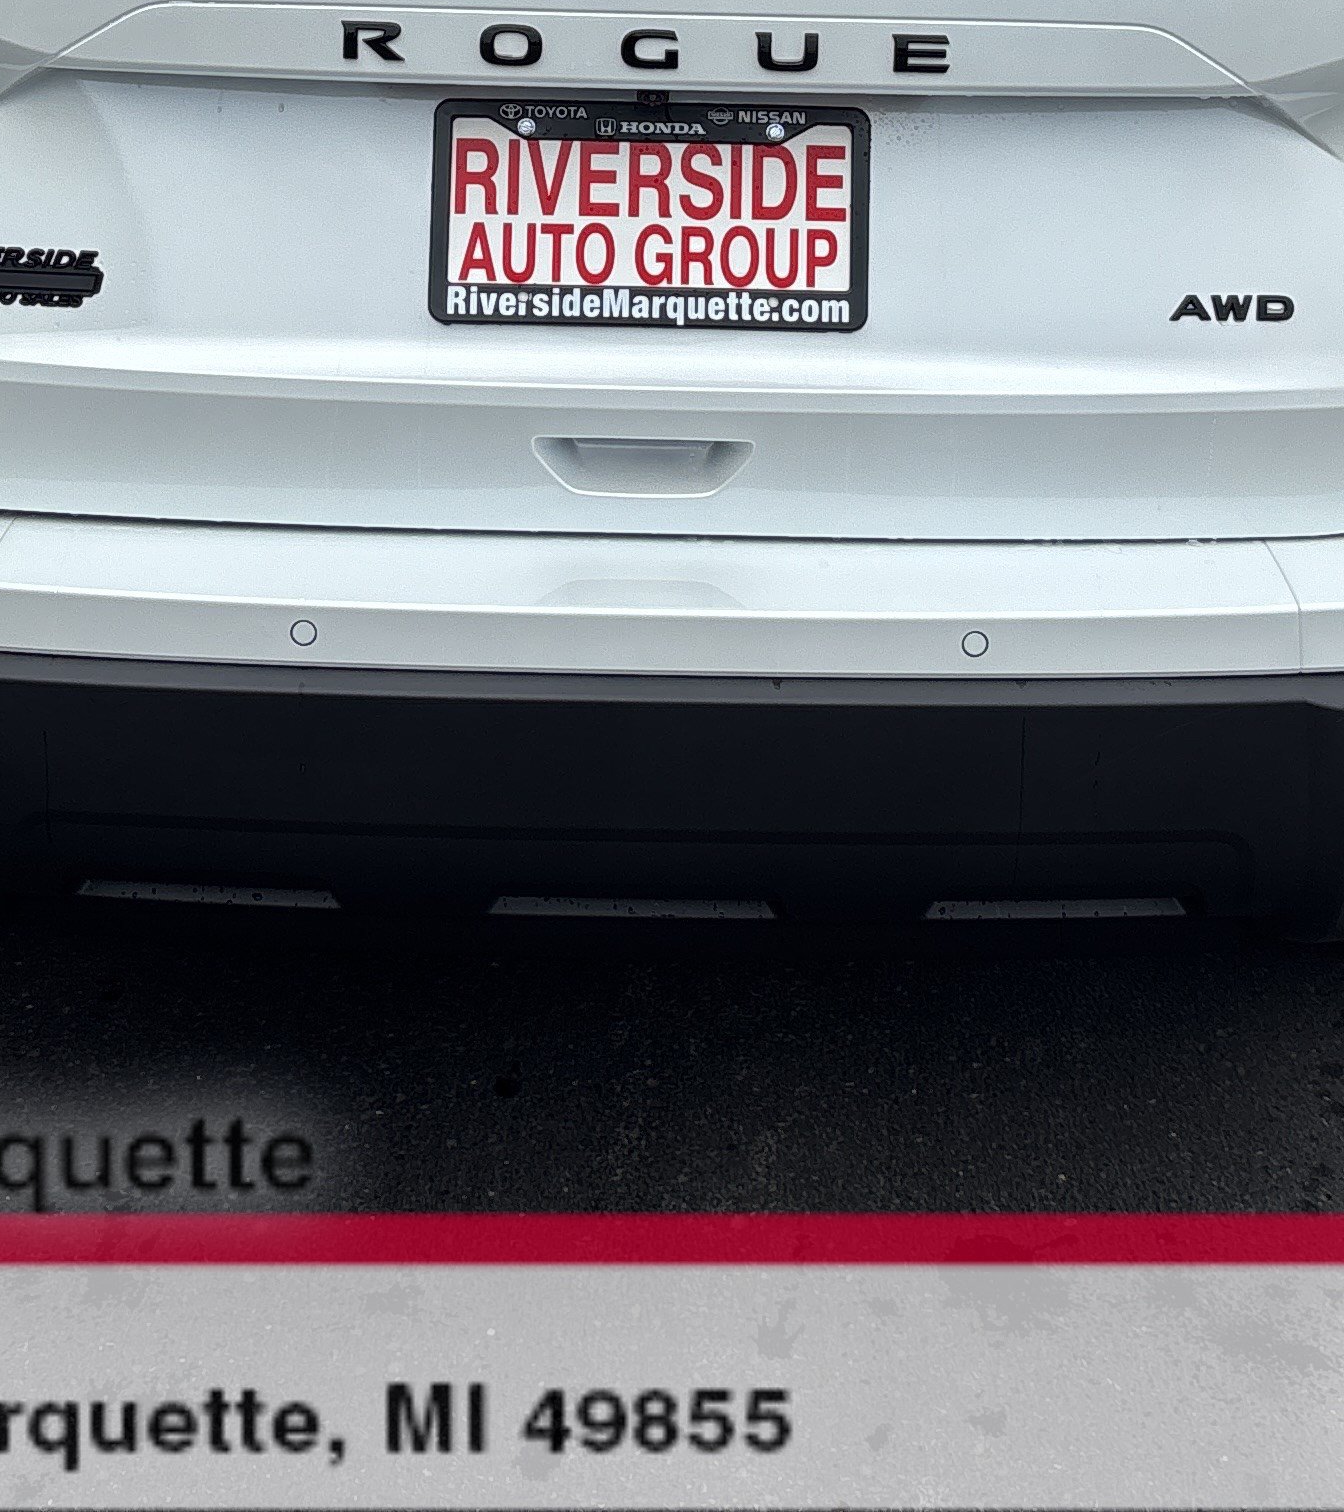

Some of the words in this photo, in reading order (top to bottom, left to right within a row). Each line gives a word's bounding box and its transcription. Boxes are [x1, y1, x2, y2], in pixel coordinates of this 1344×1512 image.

[340, 19, 951, 74] ROGUE
[524, 105, 588, 119] TOYOTA
[619, 121, 707, 135] HONDA
[737, 110, 806, 125] NISSAN
[453, 137, 848, 223] RIVERSIDE
[457, 221, 616, 286] AUTO
[633, 224, 839, 289] GROUP
[445, 286, 850, 326] RiversideMarquette.com
[1168, 294, 1295, 323] AWD
